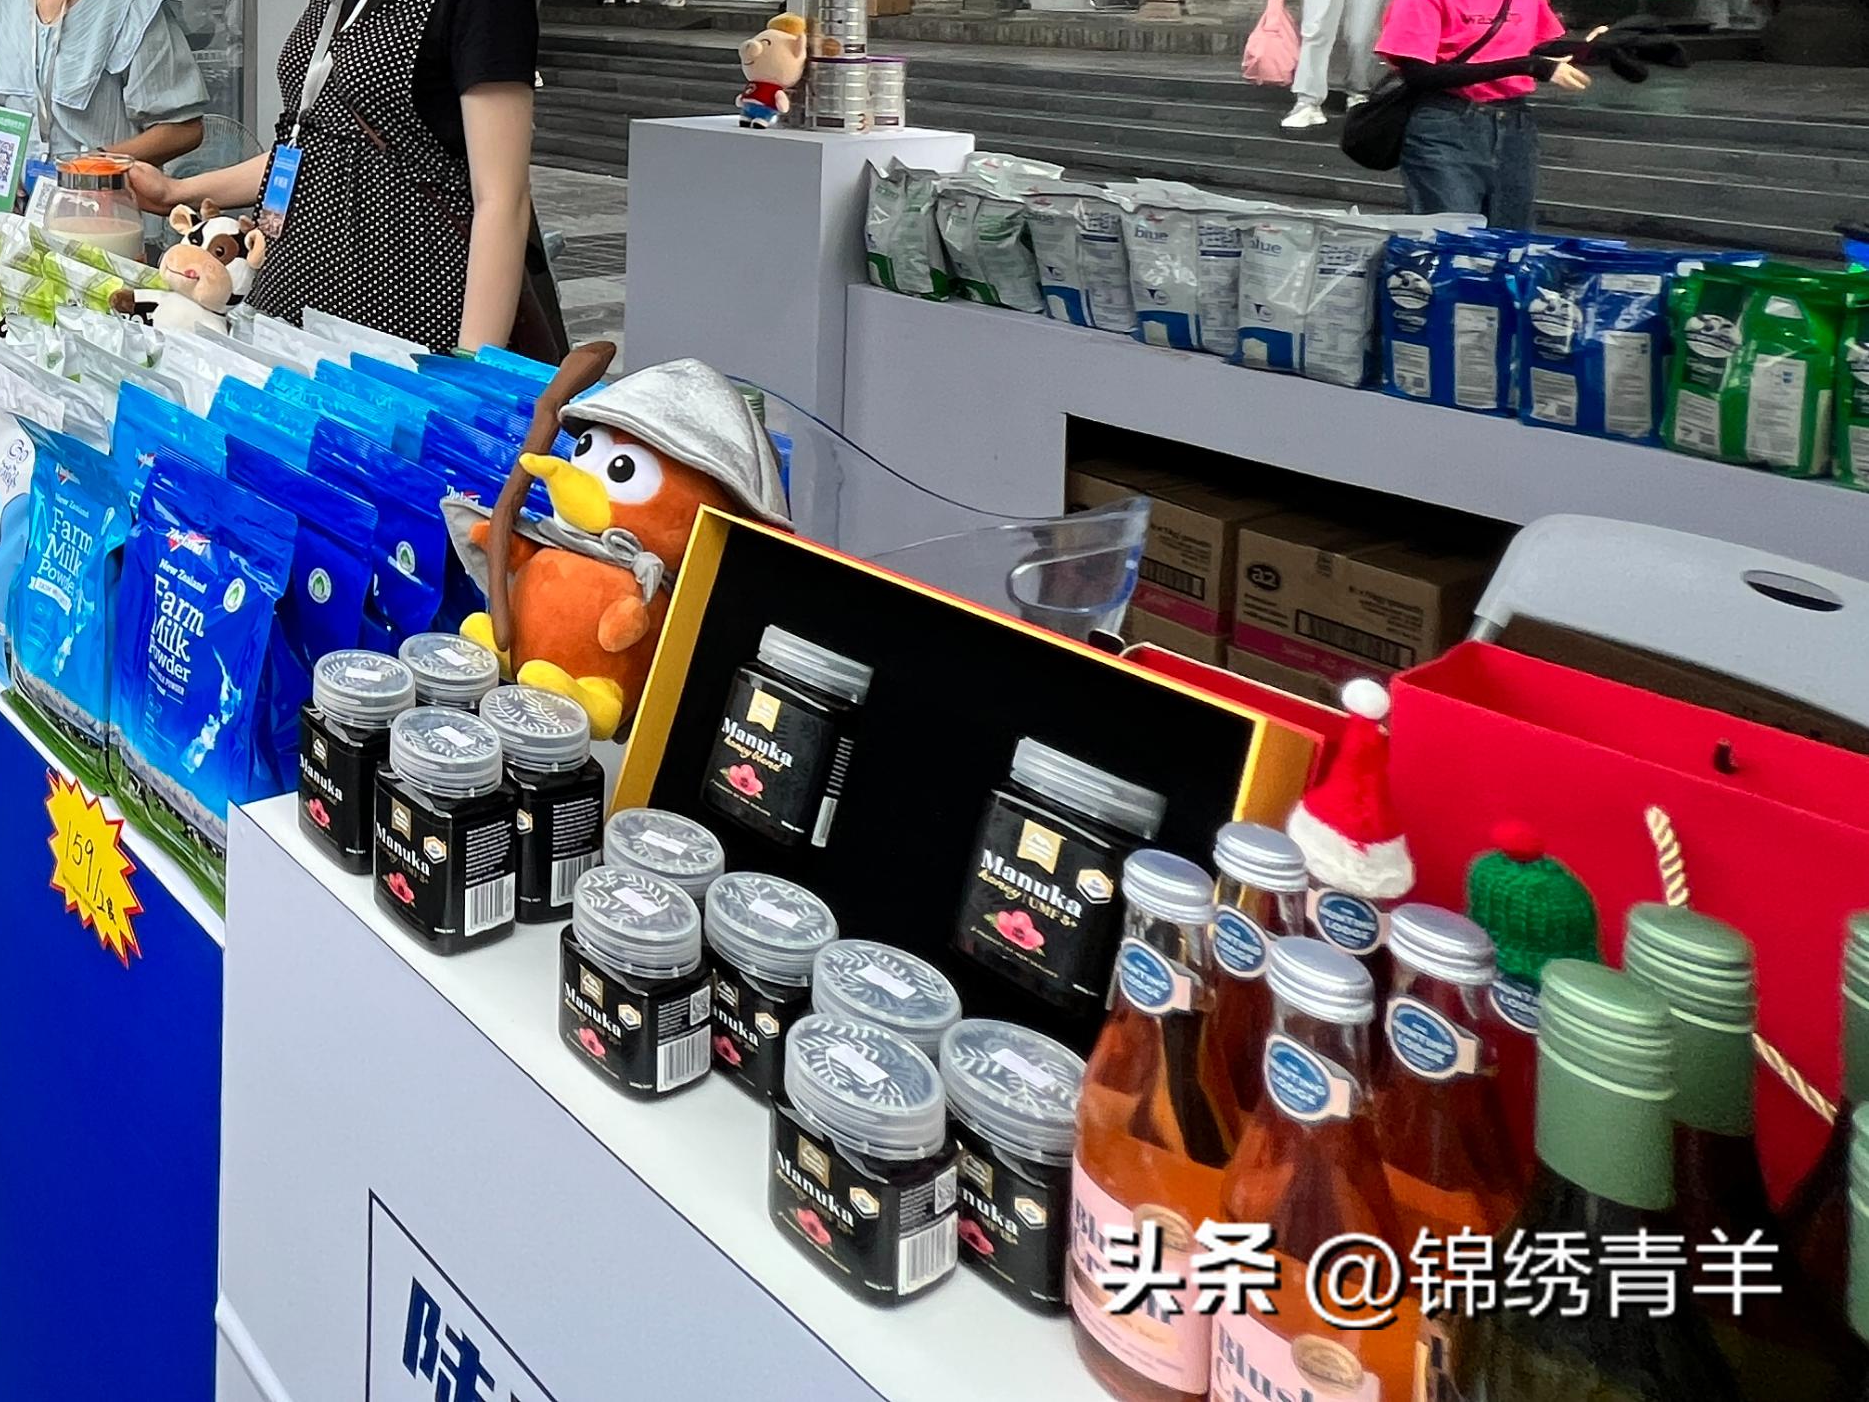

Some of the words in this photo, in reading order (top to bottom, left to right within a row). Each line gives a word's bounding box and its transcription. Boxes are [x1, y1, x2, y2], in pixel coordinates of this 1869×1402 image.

[1134, 226, 1169, 241] blue
[42, 533, 83, 578] Milk
[52, 506, 94, 556] Farm
[159, 558, 178, 578] New
[178, 568, 208, 595] Zealand
[154, 574, 205, 638] Farm
[148, 634, 192, 683] Powder
[150, 614, 191, 664] Milk
[721, 716, 794, 768] Manuka
[299, 752, 343, 802] Manuka
[375, 821, 431, 877] Manuka
[977, 868, 1022, 901] honey
[980, 848, 1083, 919] Manuka
[564, 982, 622, 1039] Manuka
[777, 1150, 855, 1228] Manuka
[402, 1276, 522, 1402] 陆
